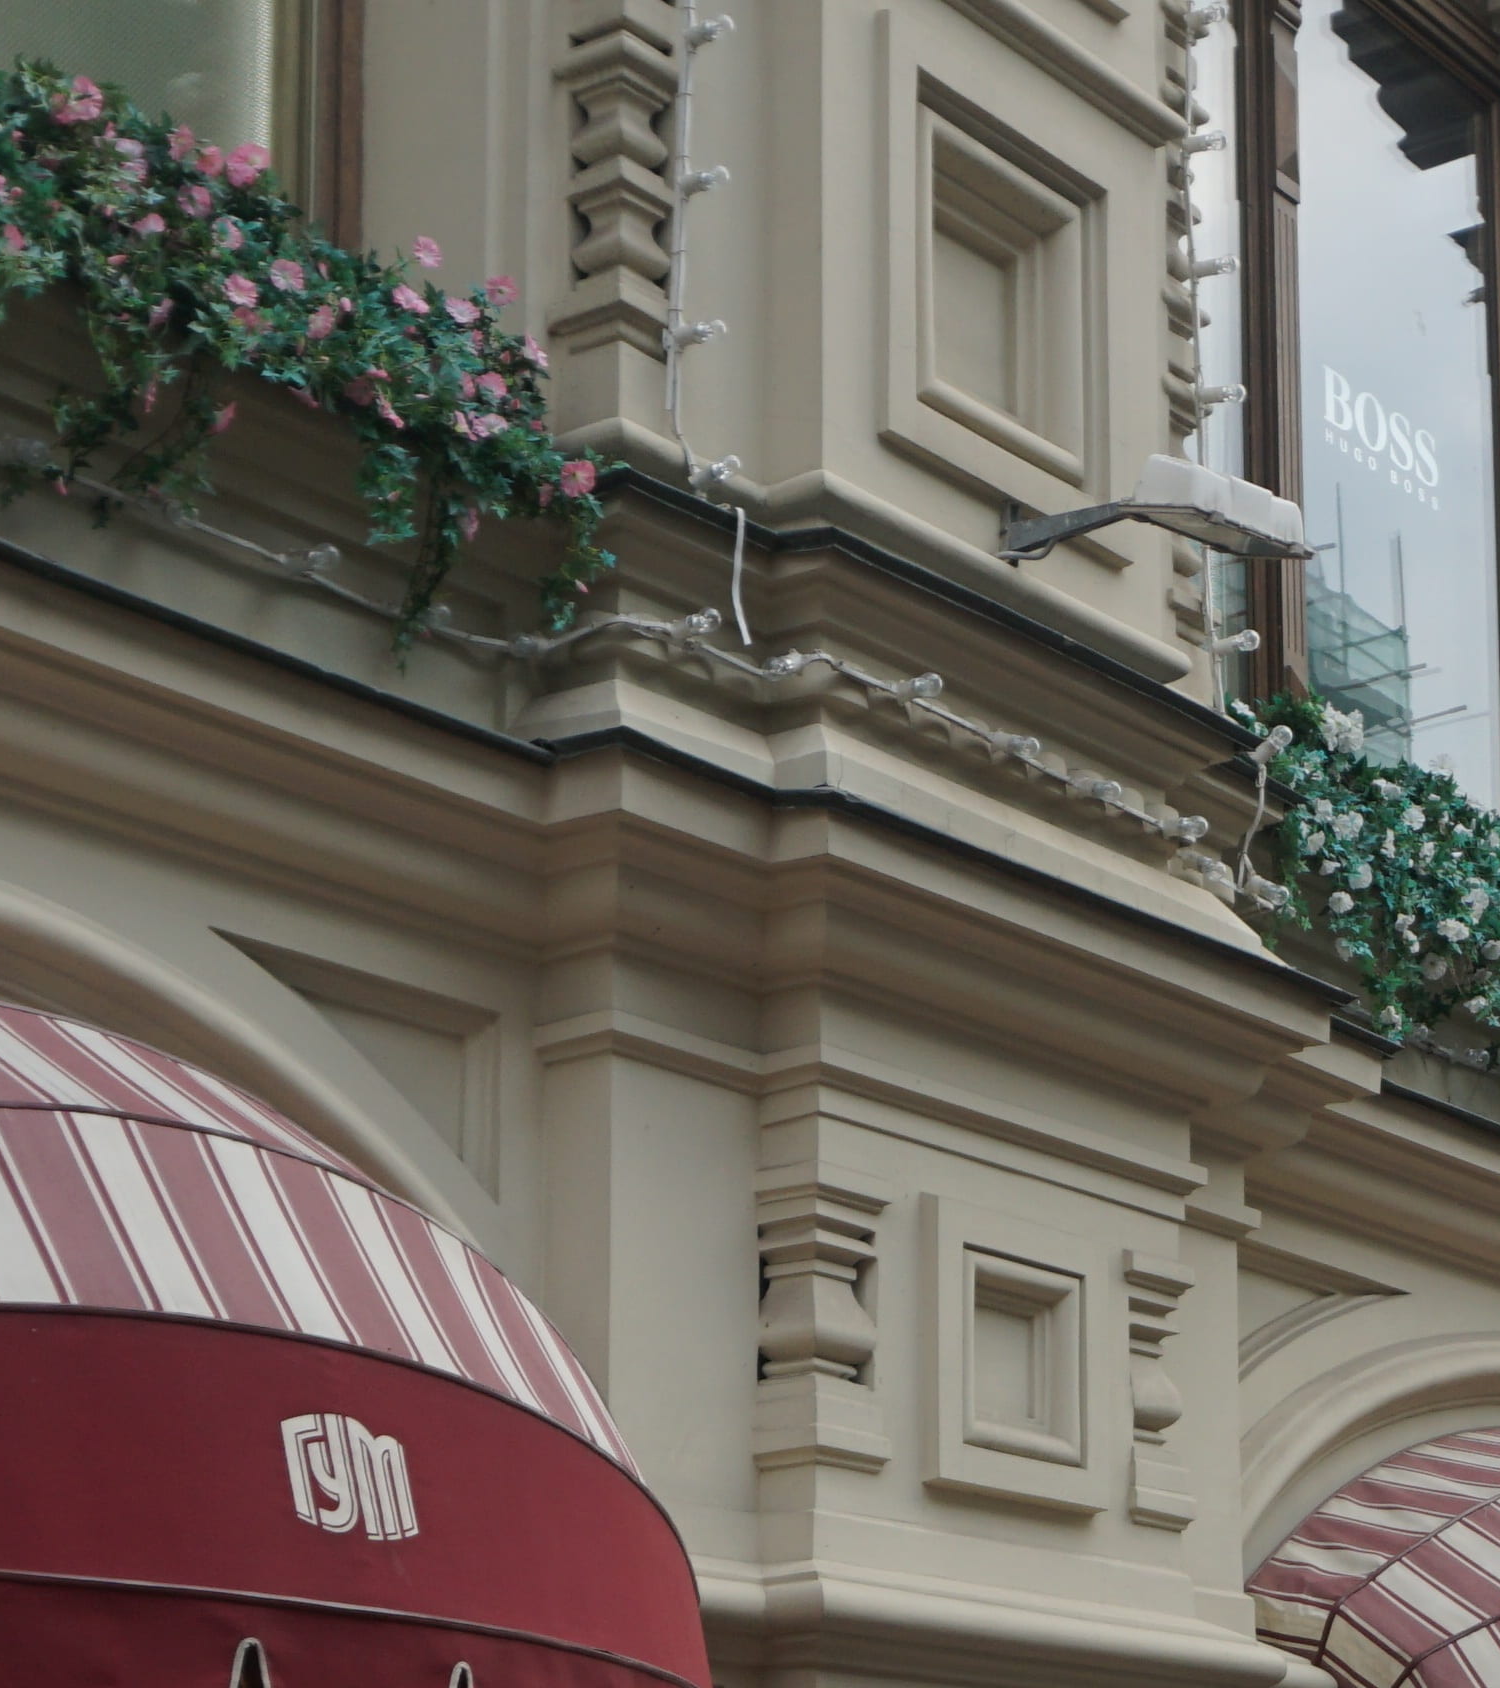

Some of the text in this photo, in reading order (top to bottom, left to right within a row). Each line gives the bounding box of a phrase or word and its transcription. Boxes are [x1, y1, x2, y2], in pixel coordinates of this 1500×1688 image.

[1323, 364, 1439, 487] BOSS
[1325, 428, 1440, 511] HUGO BOSS
